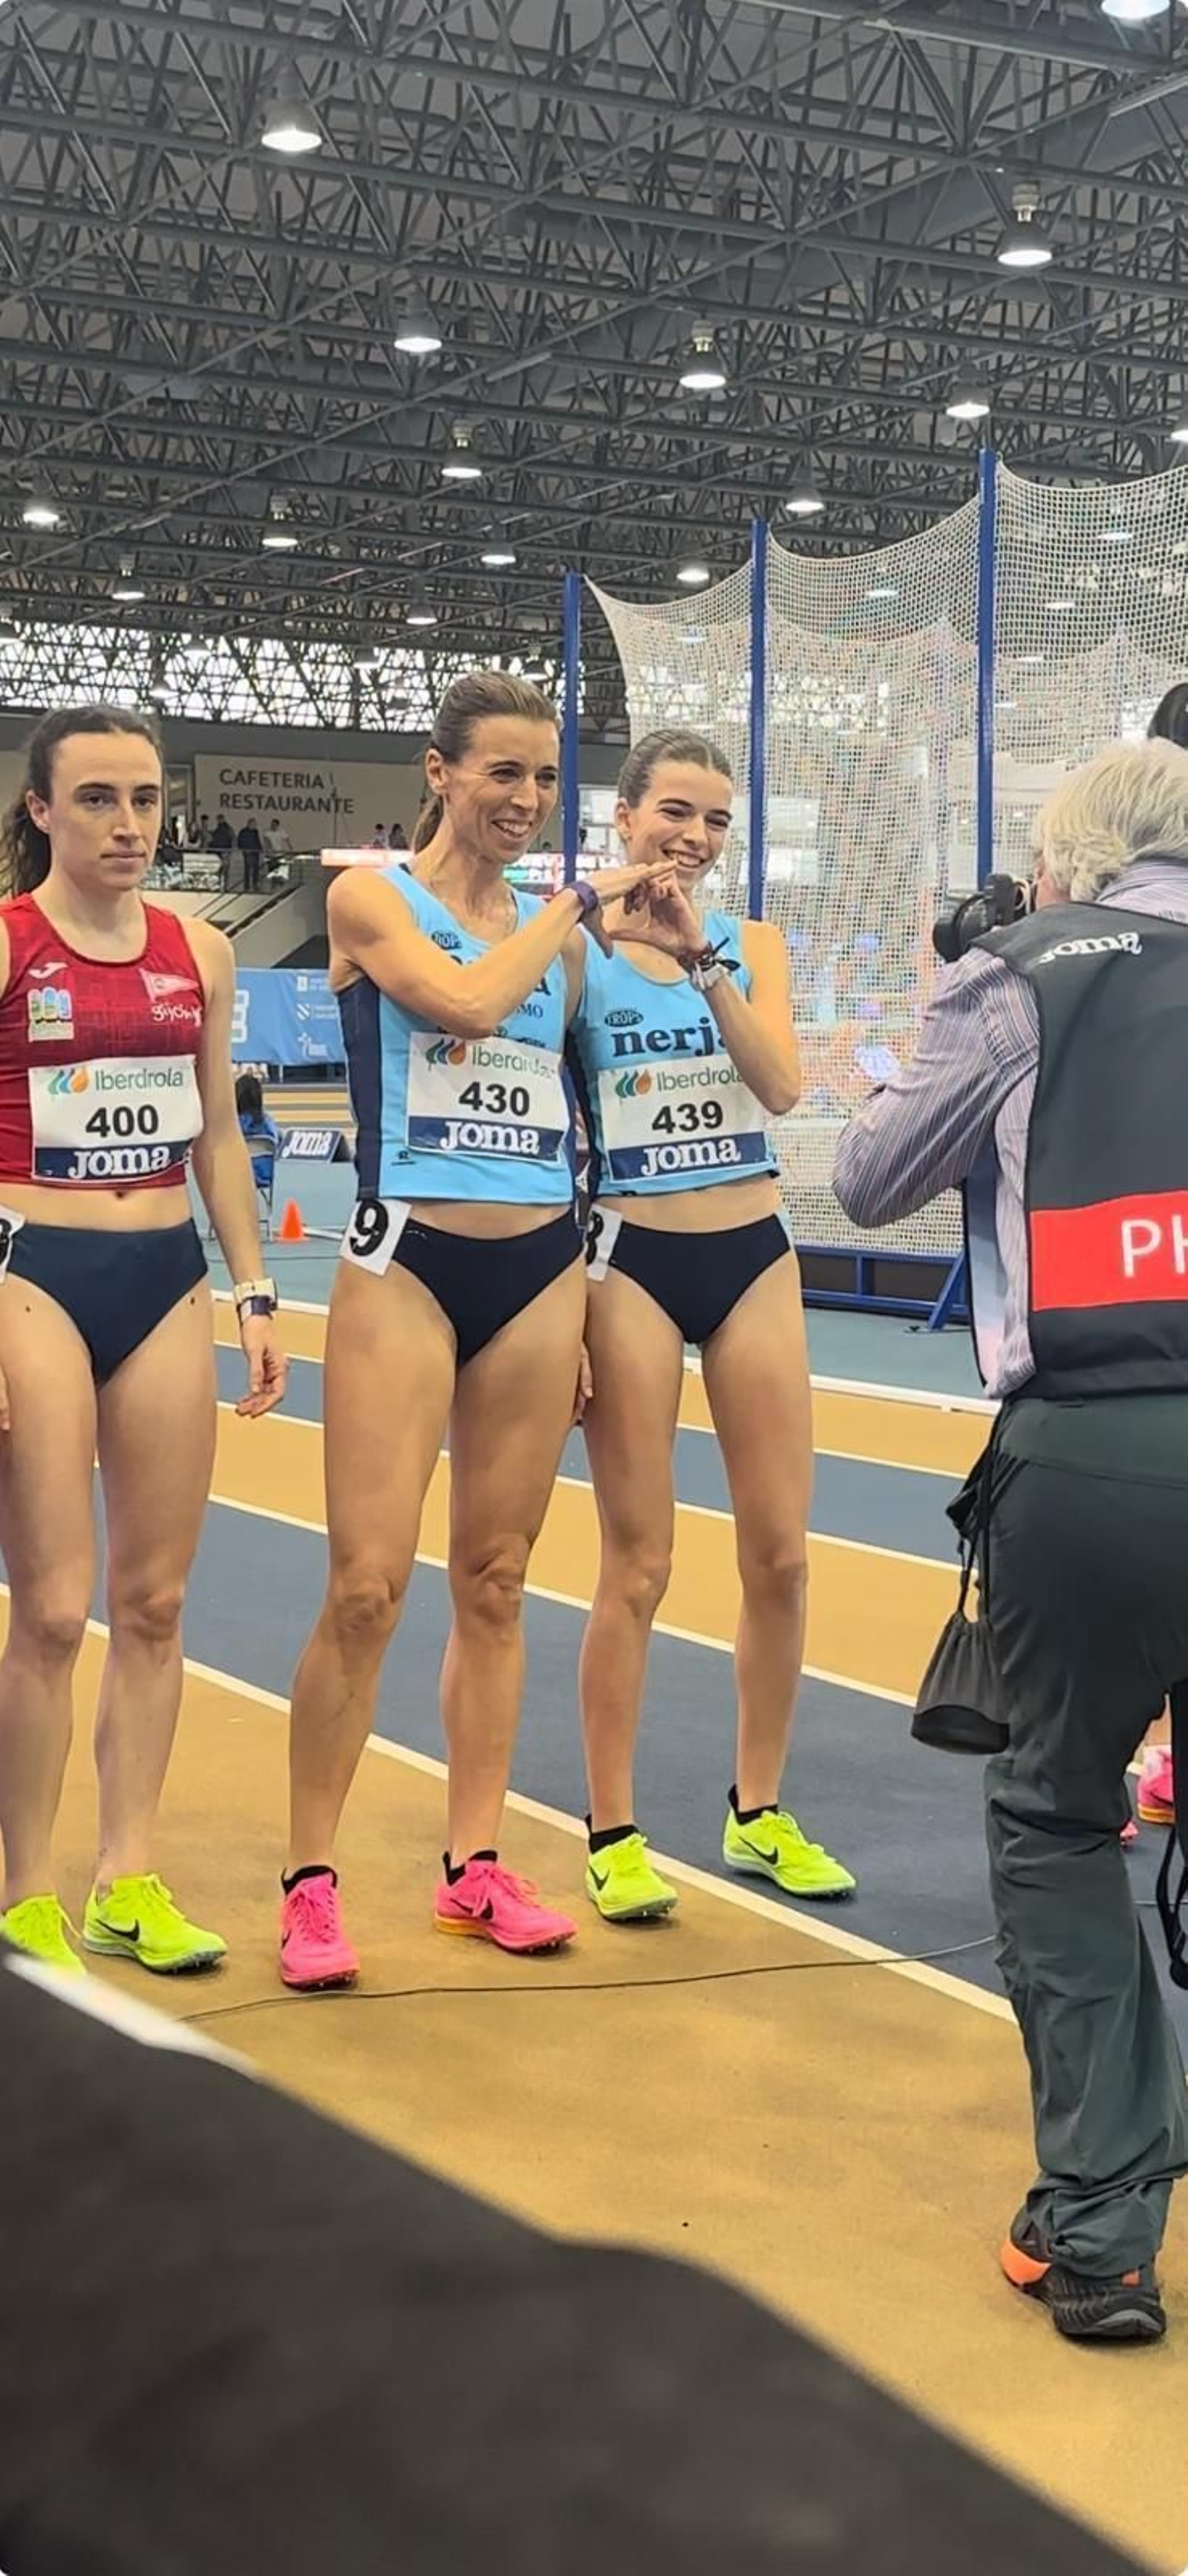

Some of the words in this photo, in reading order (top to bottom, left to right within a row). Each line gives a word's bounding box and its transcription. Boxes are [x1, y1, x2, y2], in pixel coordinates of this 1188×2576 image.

[219, 769, 324, 789] CAFETERIA
[220, 793, 354, 814] RESTAURANTE
[612, 1017, 728, 1057] nerj
[472, 1045, 555, 1079] Iberd
[95, 1068, 183, 1091] Iberdrola
[459, 1082, 529, 1117] 430
[85, 1104, 159, 1138] 400
[652, 1100, 723, 1134] 439
[349, 1199, 389, 1256] 9
